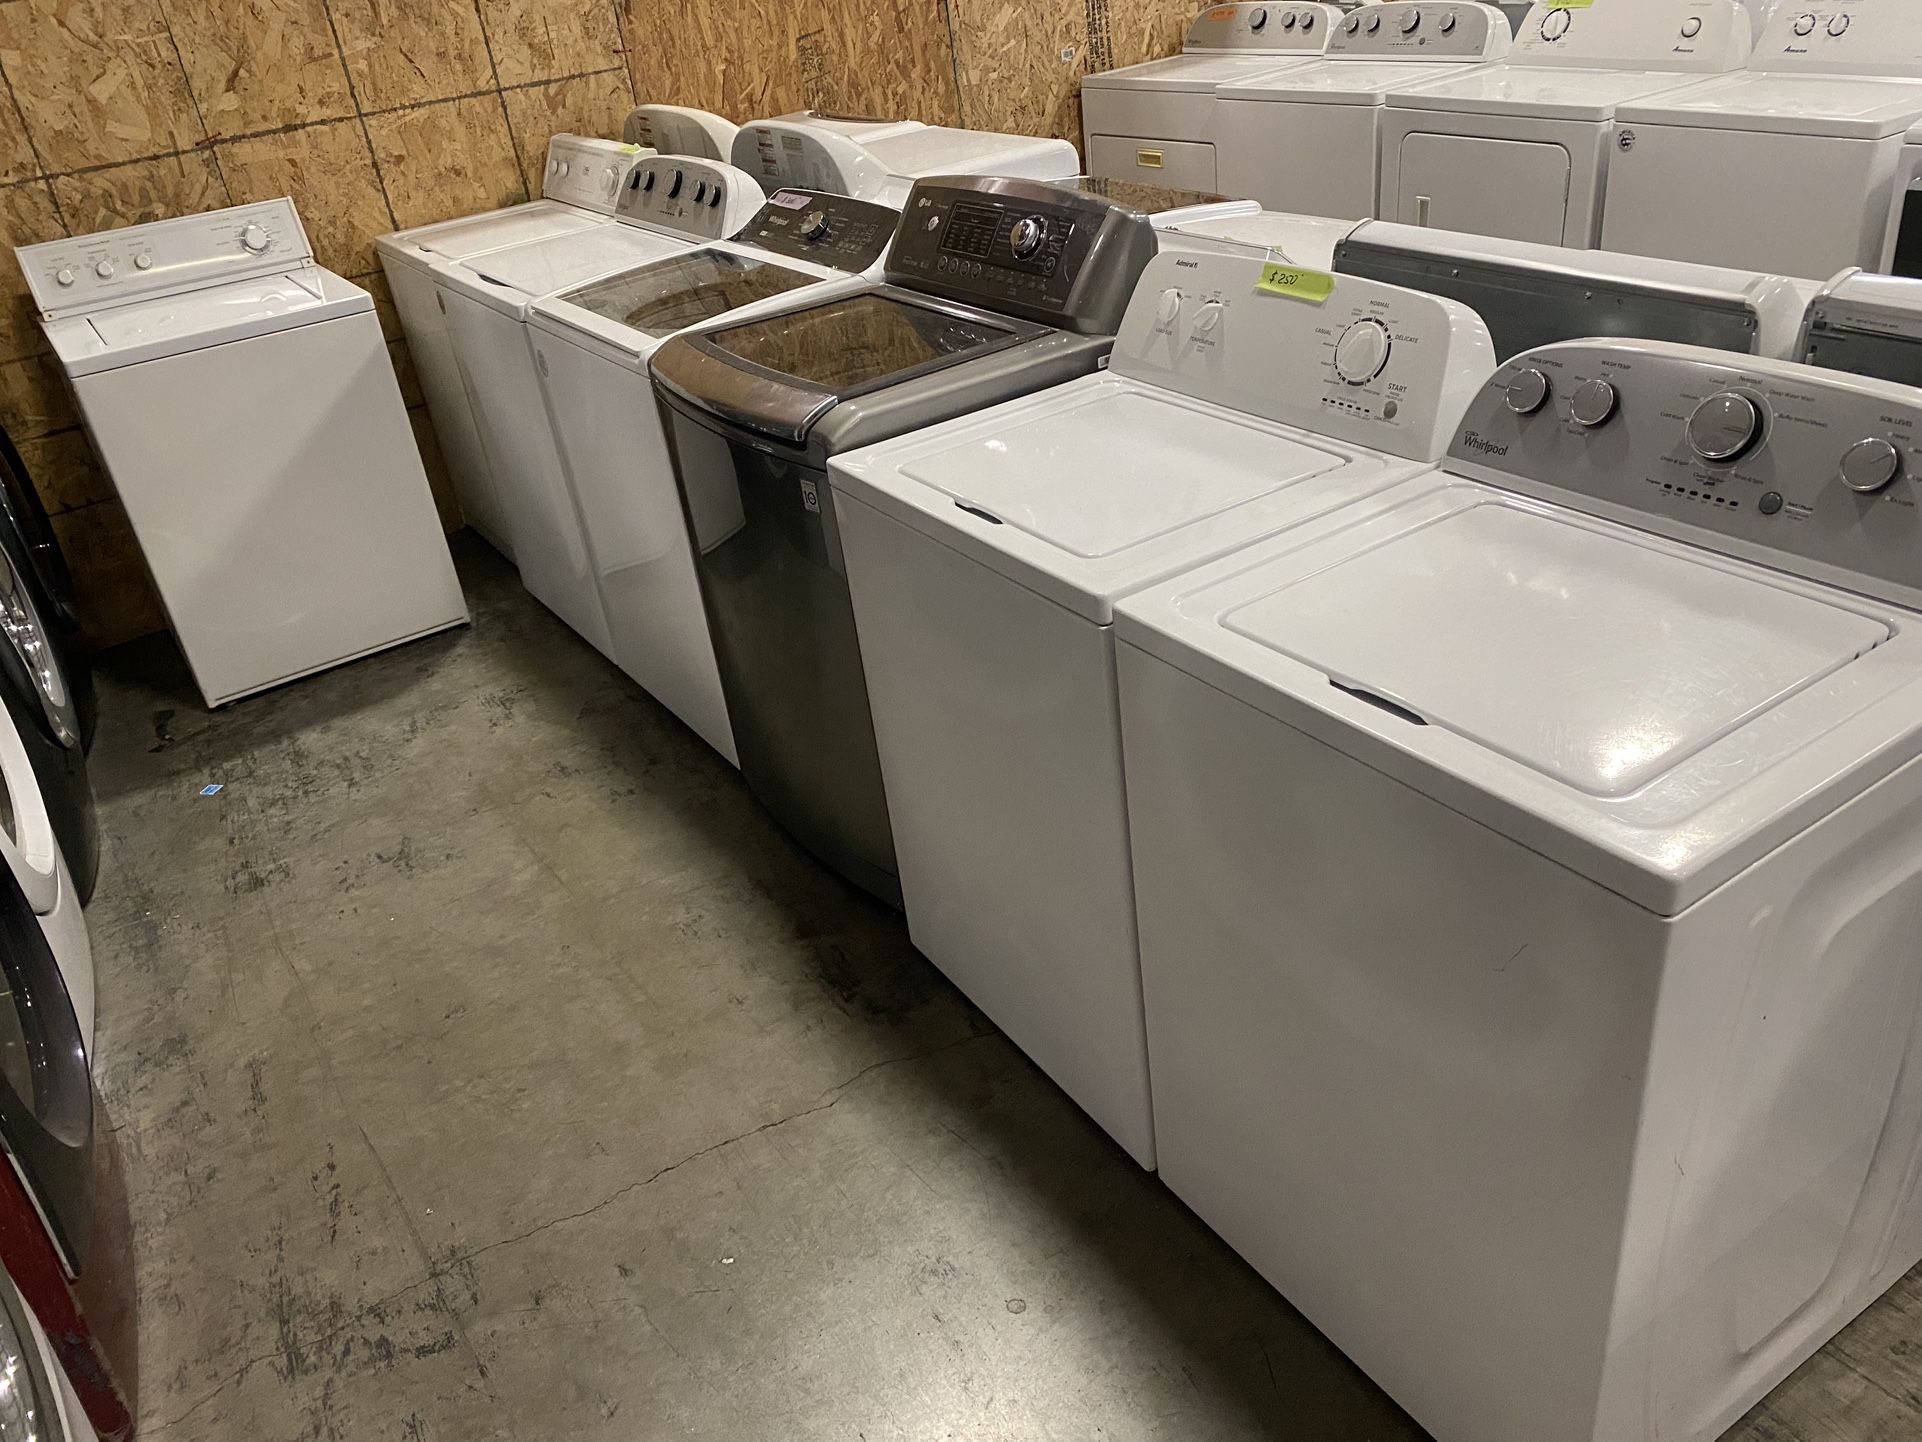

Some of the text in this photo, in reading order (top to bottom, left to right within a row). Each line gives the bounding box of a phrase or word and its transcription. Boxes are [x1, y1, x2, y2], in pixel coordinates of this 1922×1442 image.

[1176, 259, 1194, 268] Admiral
[1370, 300, 1390, 309] NORMAL
[1315, 328, 1331, 336] CASUAL
[1395, 334, 1419, 344] DELICATE
[1388, 383, 1407, 393] START
[1465, 435, 1509, 456] Whirlpool
